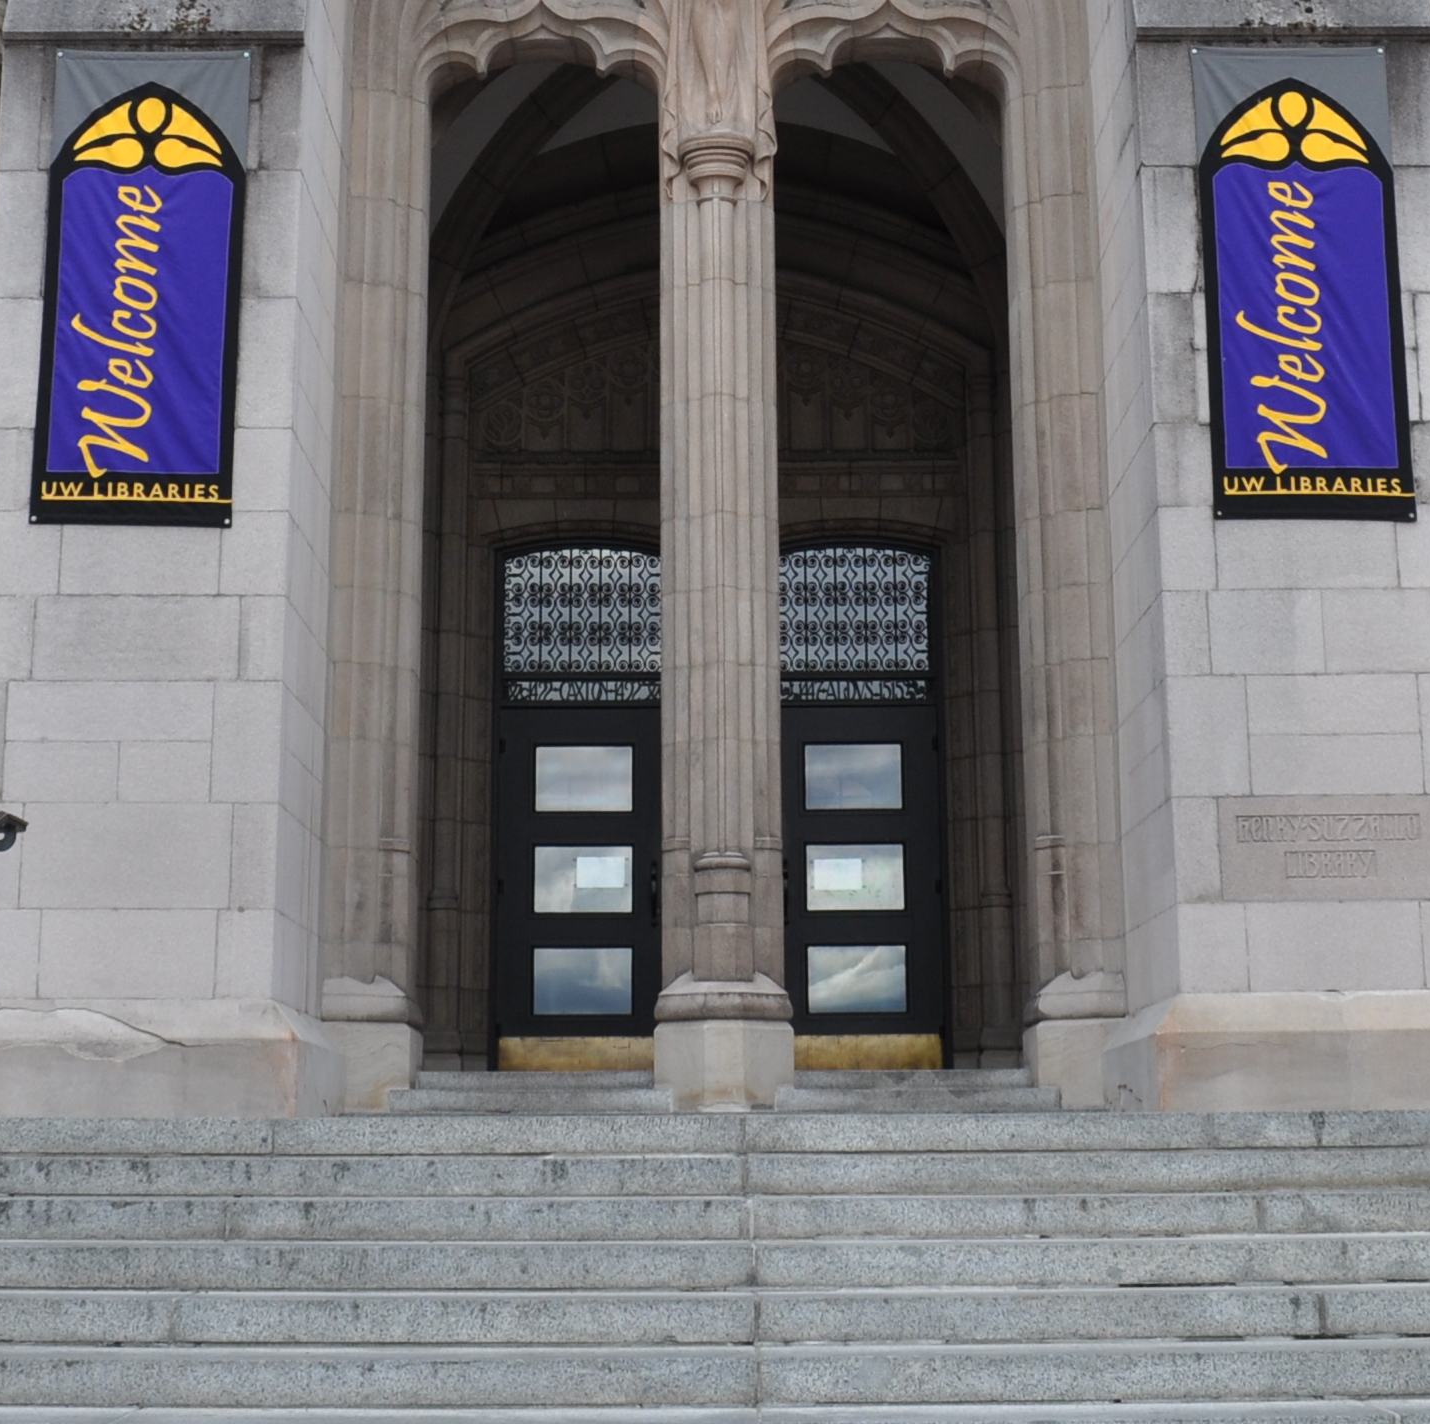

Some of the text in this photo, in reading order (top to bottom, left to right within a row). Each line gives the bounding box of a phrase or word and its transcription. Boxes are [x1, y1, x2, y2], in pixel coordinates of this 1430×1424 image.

[71, 185, 163, 478] Welcome
[1236, 181, 1328, 474] Welcome
[41, 481, 219, 500] UW LIBRARIES
[1223, 476, 1402, 494] UW LIBRARIES
[1285, 851, 1374, 879] LIBRARY
